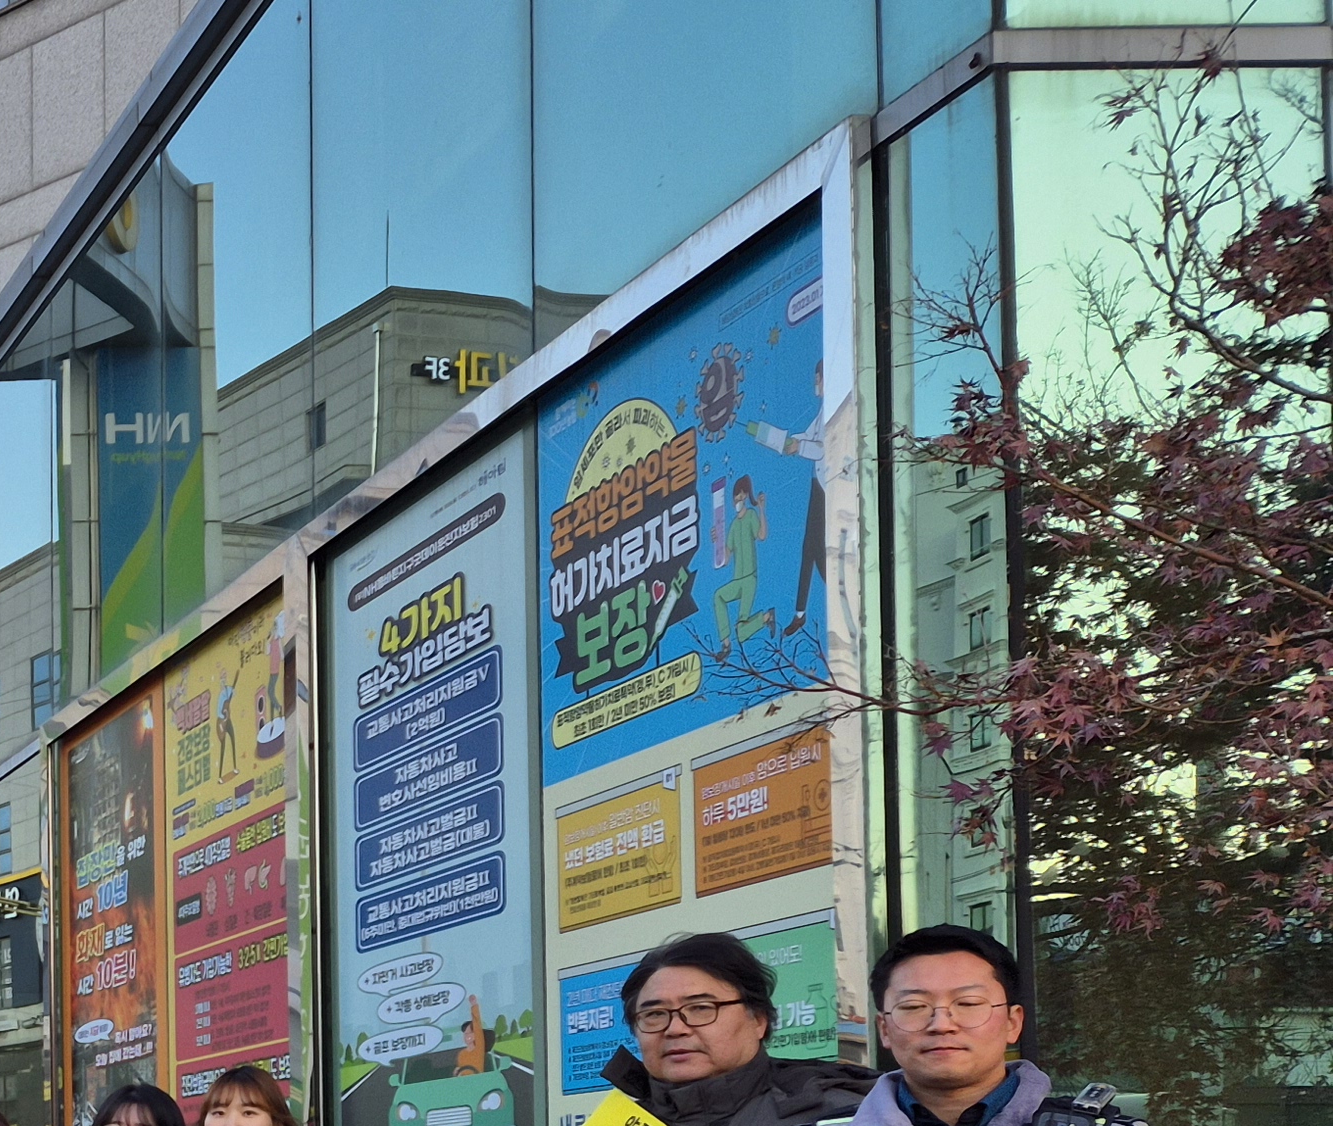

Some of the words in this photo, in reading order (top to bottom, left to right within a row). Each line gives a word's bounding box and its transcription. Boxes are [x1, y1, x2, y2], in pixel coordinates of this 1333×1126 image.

[550, 495, 699, 618] 허가치료자금
[379, 575, 462, 655] 4가지
[575, 579, 651, 687] 보장
[393, 743, 459, 785] 자동차사고
[701, 805, 725, 828] 하루
[726, 786, 769, 822] 5만원!
[585, 838, 615, 866] 보험료
[96, 869, 129, 913] 10년
[95, 949, 137, 991] 10분!
[786, 1001, 817, 1026] 가능
